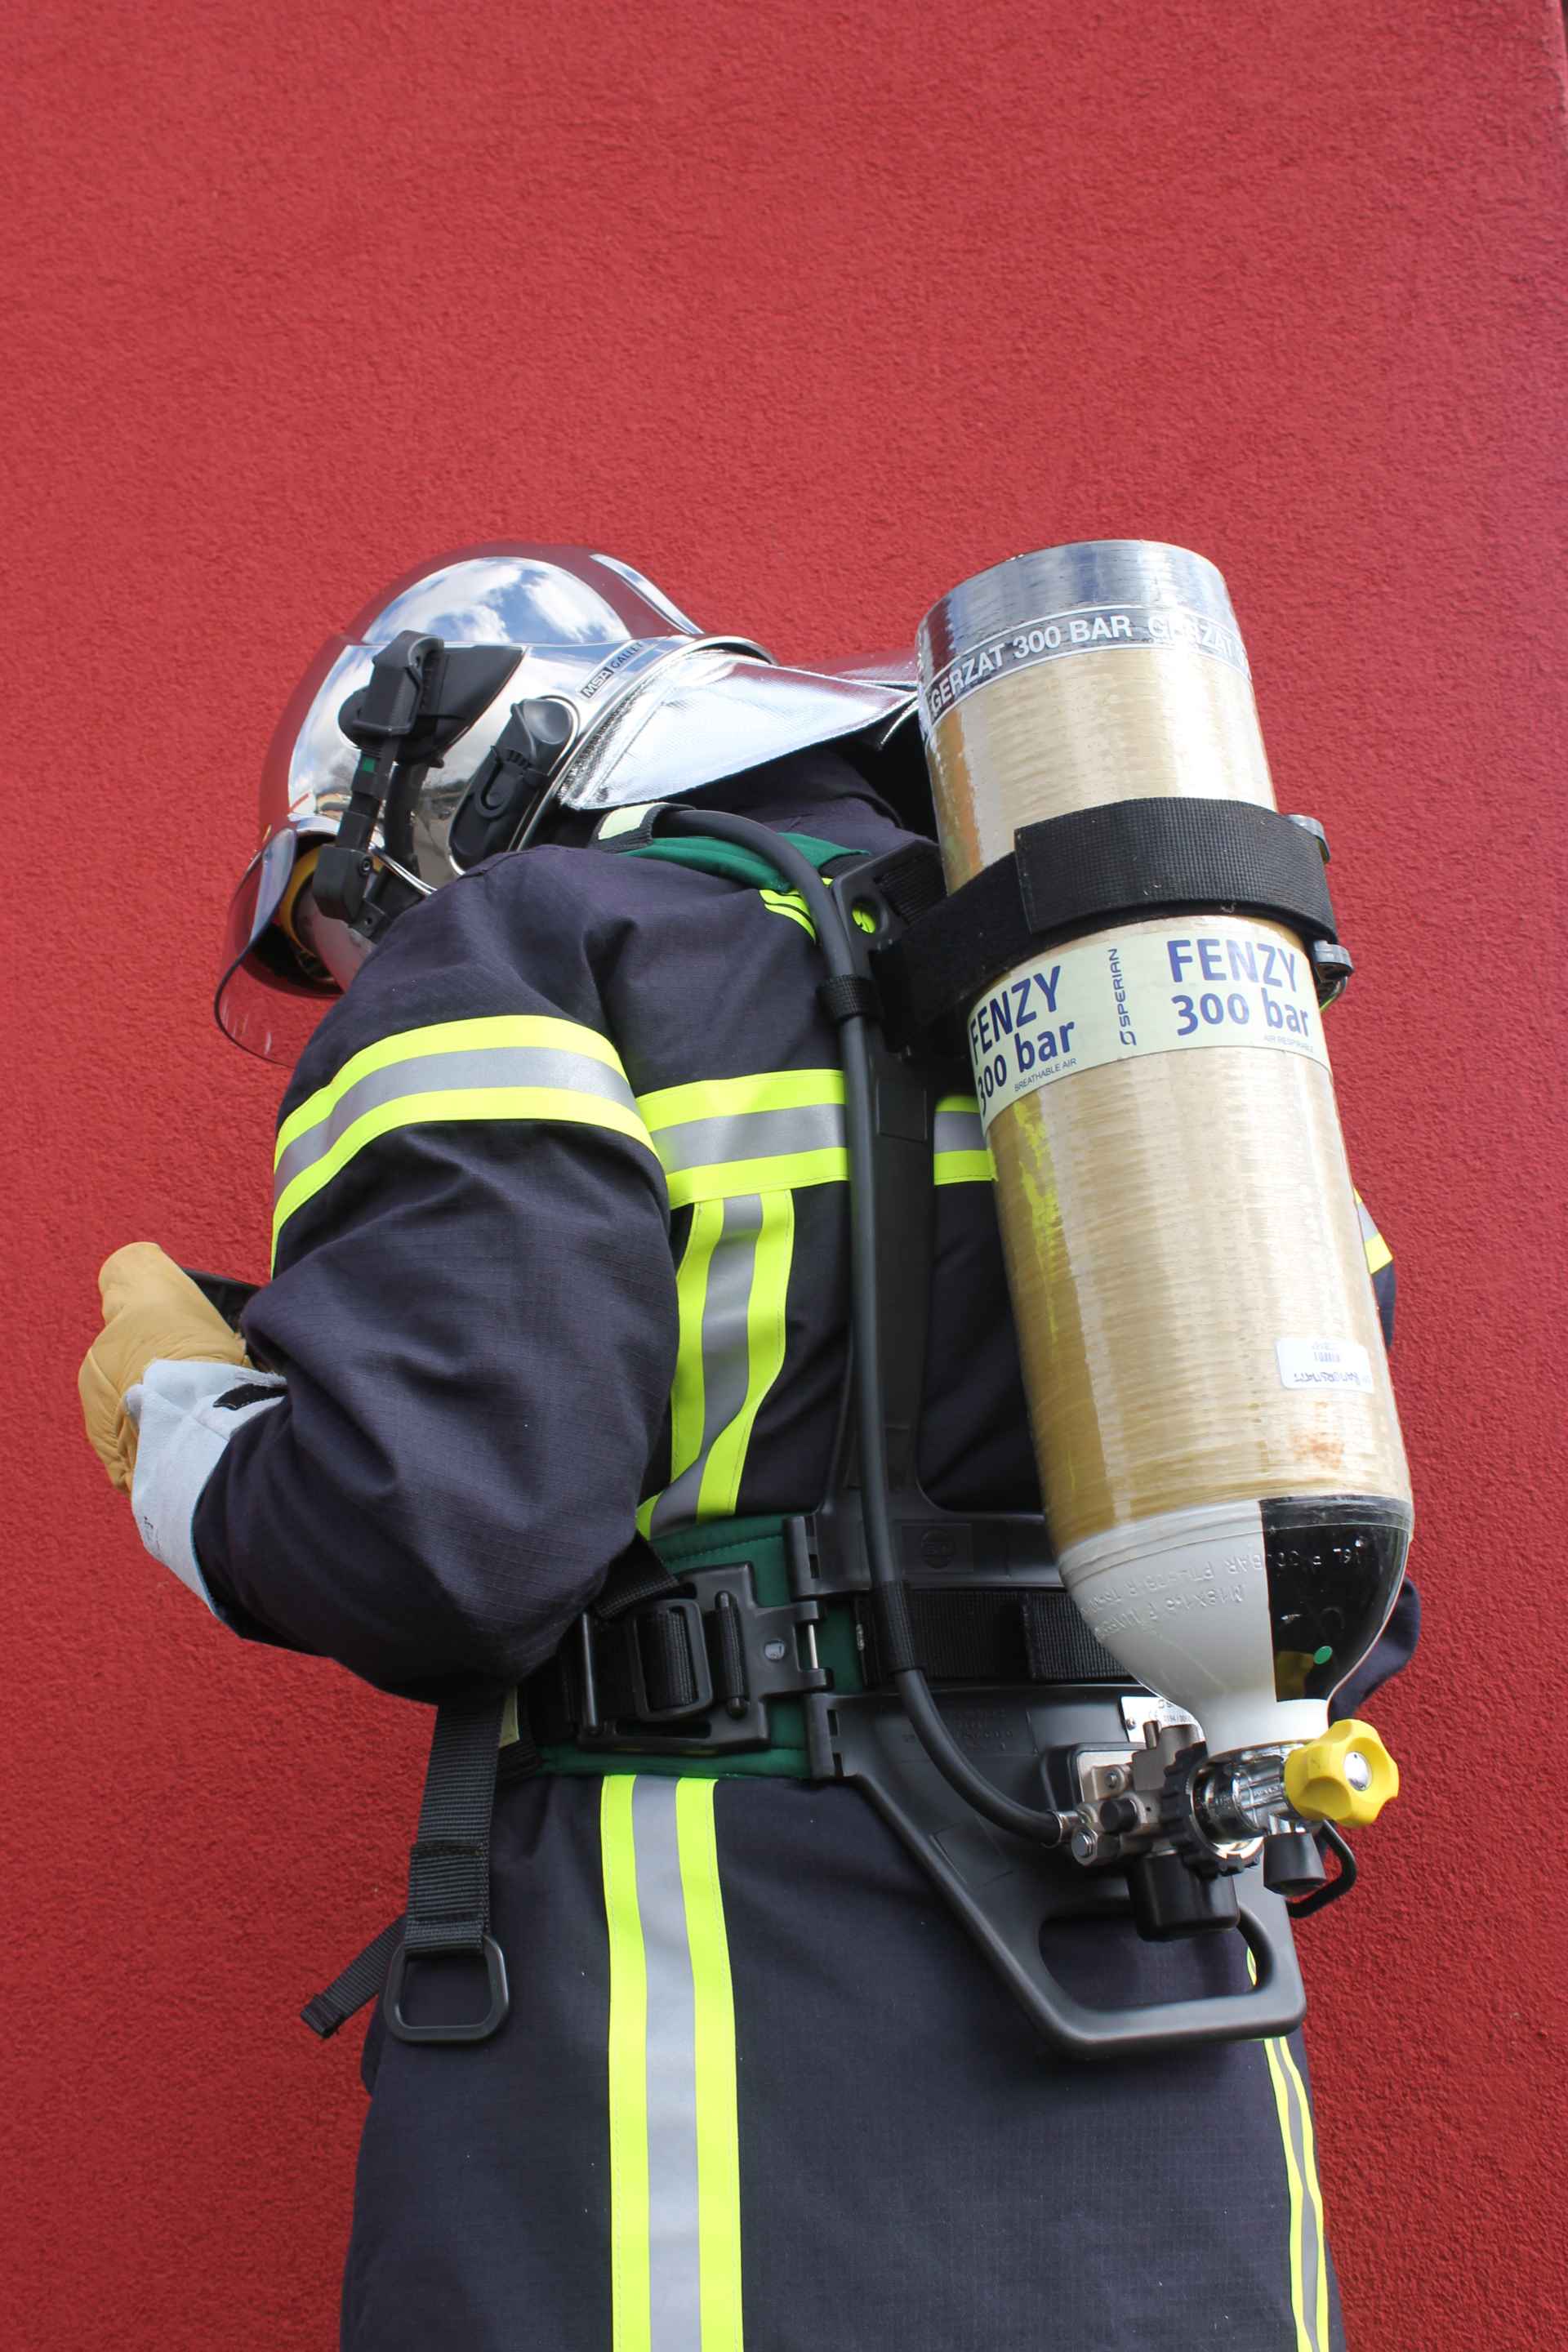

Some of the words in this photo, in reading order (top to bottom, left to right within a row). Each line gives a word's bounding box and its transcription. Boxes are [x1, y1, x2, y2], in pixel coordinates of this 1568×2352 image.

[582, 668, 612, 697] MSA
[611, 643, 643, 668] GALLET
[930, 641, 1005, 714] GERZAT
[1013, 625, 1062, 658] 300
[1069, 615, 1132, 644] BAR
[1107, 948, 1132, 1027] SPERIAN
[1166, 938, 1297, 992] FENZY
[970, 965, 1061, 1065] FENZY
[1171, 993, 1250, 1036] 300
[1261, 988, 1308, 1037] bar
[977, 1054, 1007, 1117] 300
[1014, 1022, 1075, 1073] bar
[1014, 1063, 1061, 1092] BREATHABLE
[1062, 1058, 1077, 1070] AIR
